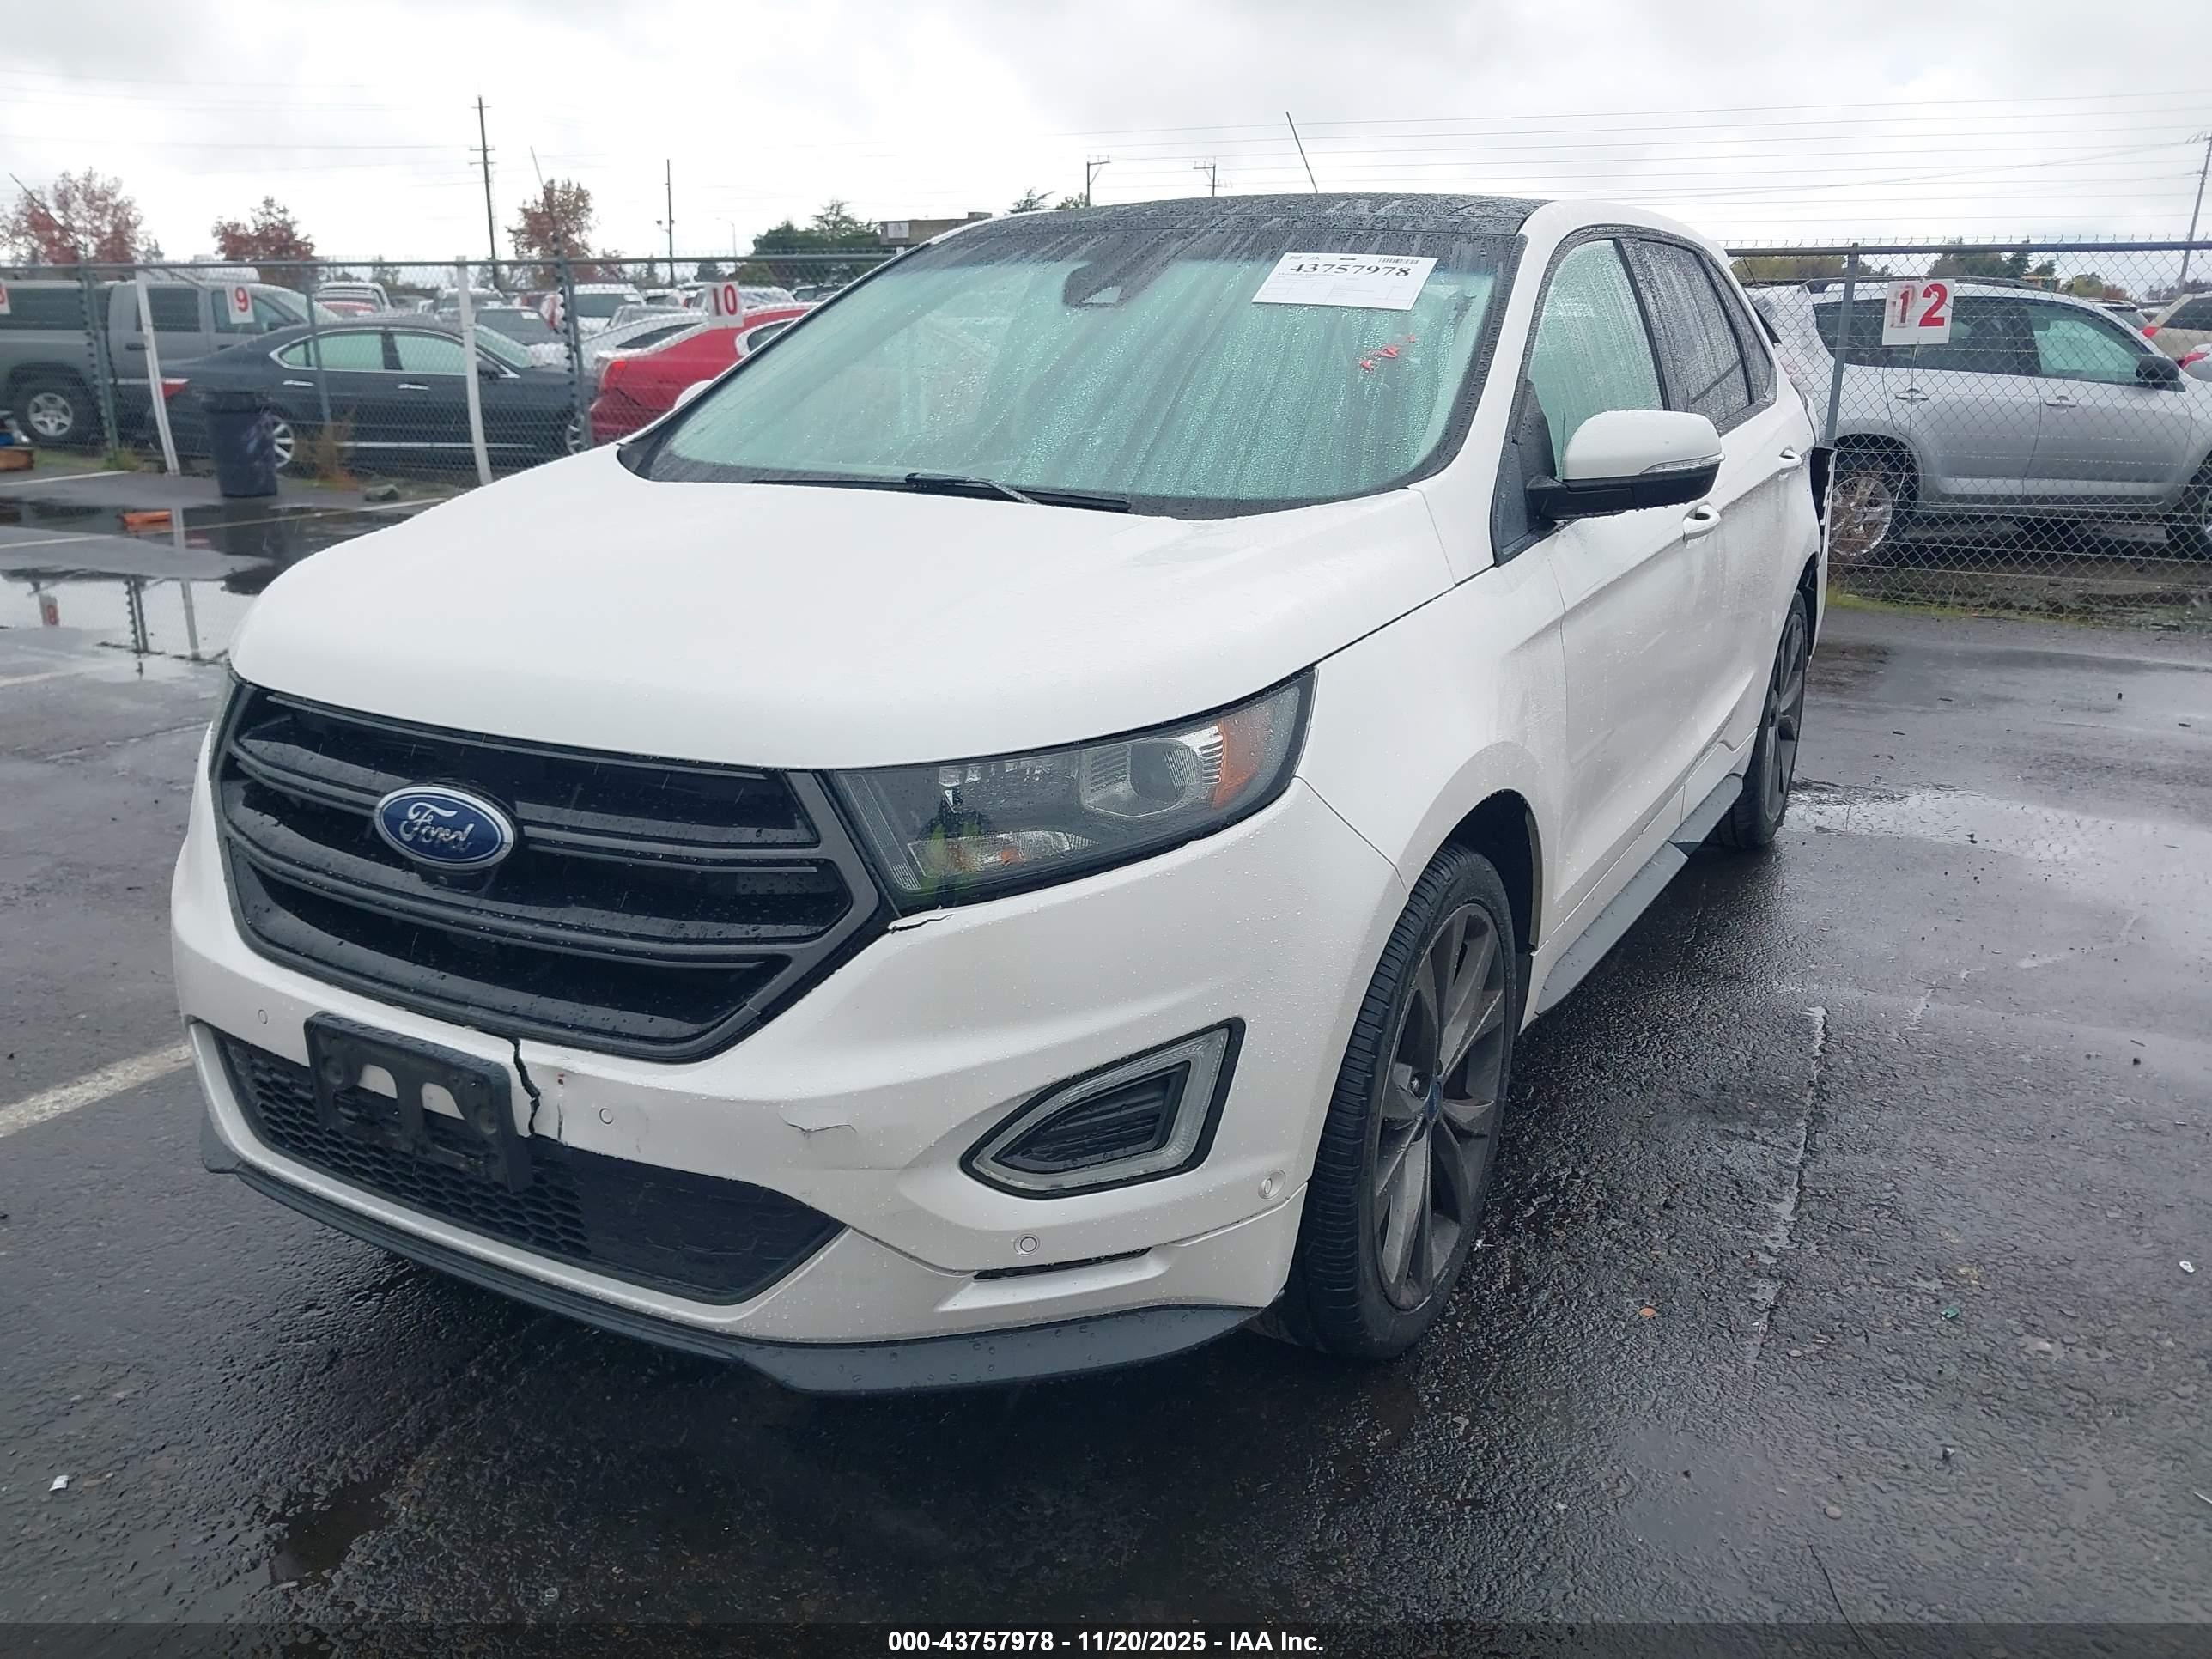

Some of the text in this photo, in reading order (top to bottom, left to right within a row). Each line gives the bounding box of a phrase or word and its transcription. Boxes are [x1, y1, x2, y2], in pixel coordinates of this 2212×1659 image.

[1289, 263, 1412, 277] 43757978
[234, 287, 249, 313] 9
[713, 284, 738, 316] 10
[1899, 283, 1948, 327] 12
[399, 802, 475, 842] Ford
